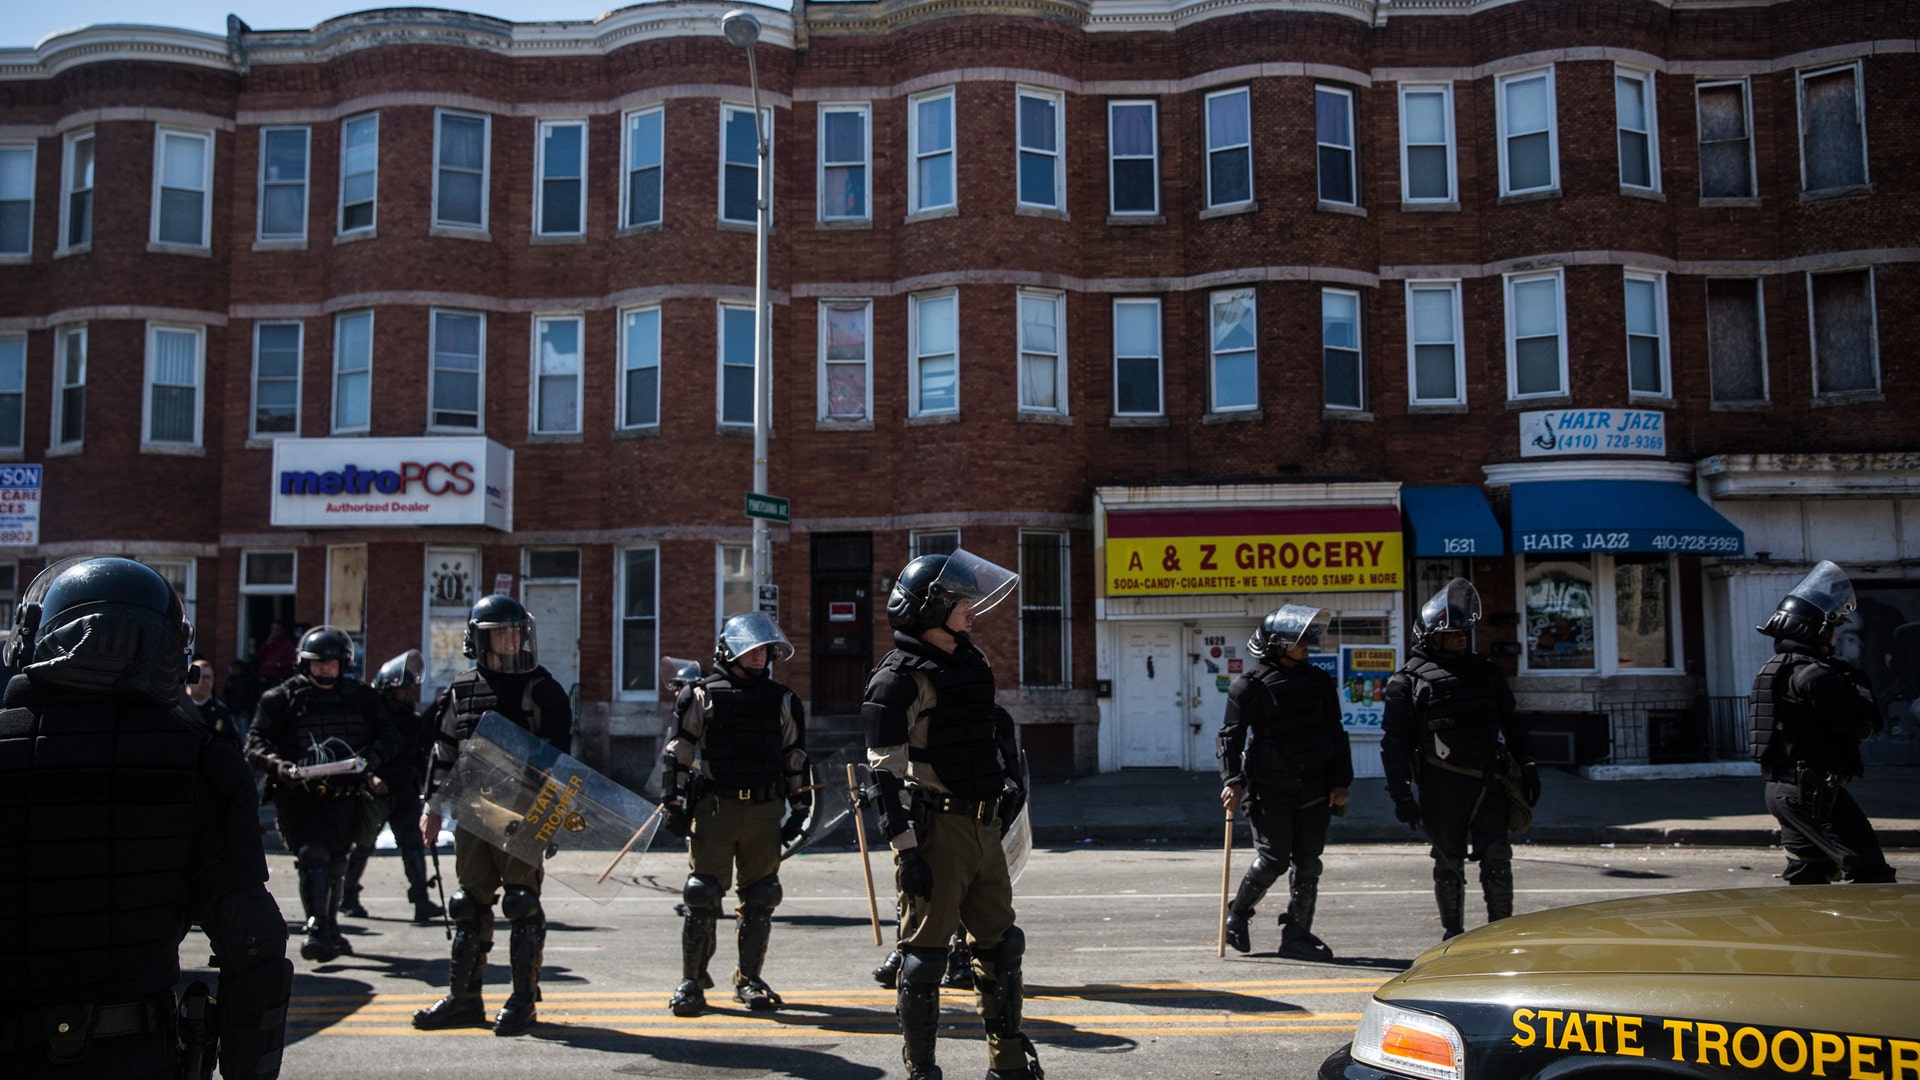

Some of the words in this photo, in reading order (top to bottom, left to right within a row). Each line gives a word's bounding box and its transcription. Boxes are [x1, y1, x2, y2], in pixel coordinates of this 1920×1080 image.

[1558, 412, 1611, 430] HAIR
[1617, 412, 1662, 431] JAZZ
[1558, 434, 1598, 450] (410)
[1606, 434, 1663, 449] 728-9369
[0, 468, 39, 486] SON
[280, 461, 475, 496] metroPCS
[2, 489, 38, 501] CARE
[326, 503, 388, 513] Authorized
[391, 502, 430, 512] Dealer
[1444, 539, 1475, 553] 1631
[1523, 534, 1574, 550] HAIR
[1582, 533, 1630, 549] JAZZ
[1652, 535, 1739, 551] 410-728-9369
[1128, 551, 1144, 571] A
[1162, 545, 1182, 571] &
[1200, 544, 1218, 571] Z
[1234, 540, 1385, 570] GROCERY
[1262, 575, 1287, 586] TAKE
[1291, 575, 1318, 586] FOOD
[1322, 574, 1354, 585] STAMP
[1358, 574, 1365, 584] &
[1369, 573, 1397, 584] MORE
[1204, 636, 1225, 646] 1629
[526, 779, 561, 825] STATE
[534, 775, 583, 843] TROOPER
[1511, 1008, 1645, 1057] STATE
[1663, 1019, 1920, 1080] TROOPER
